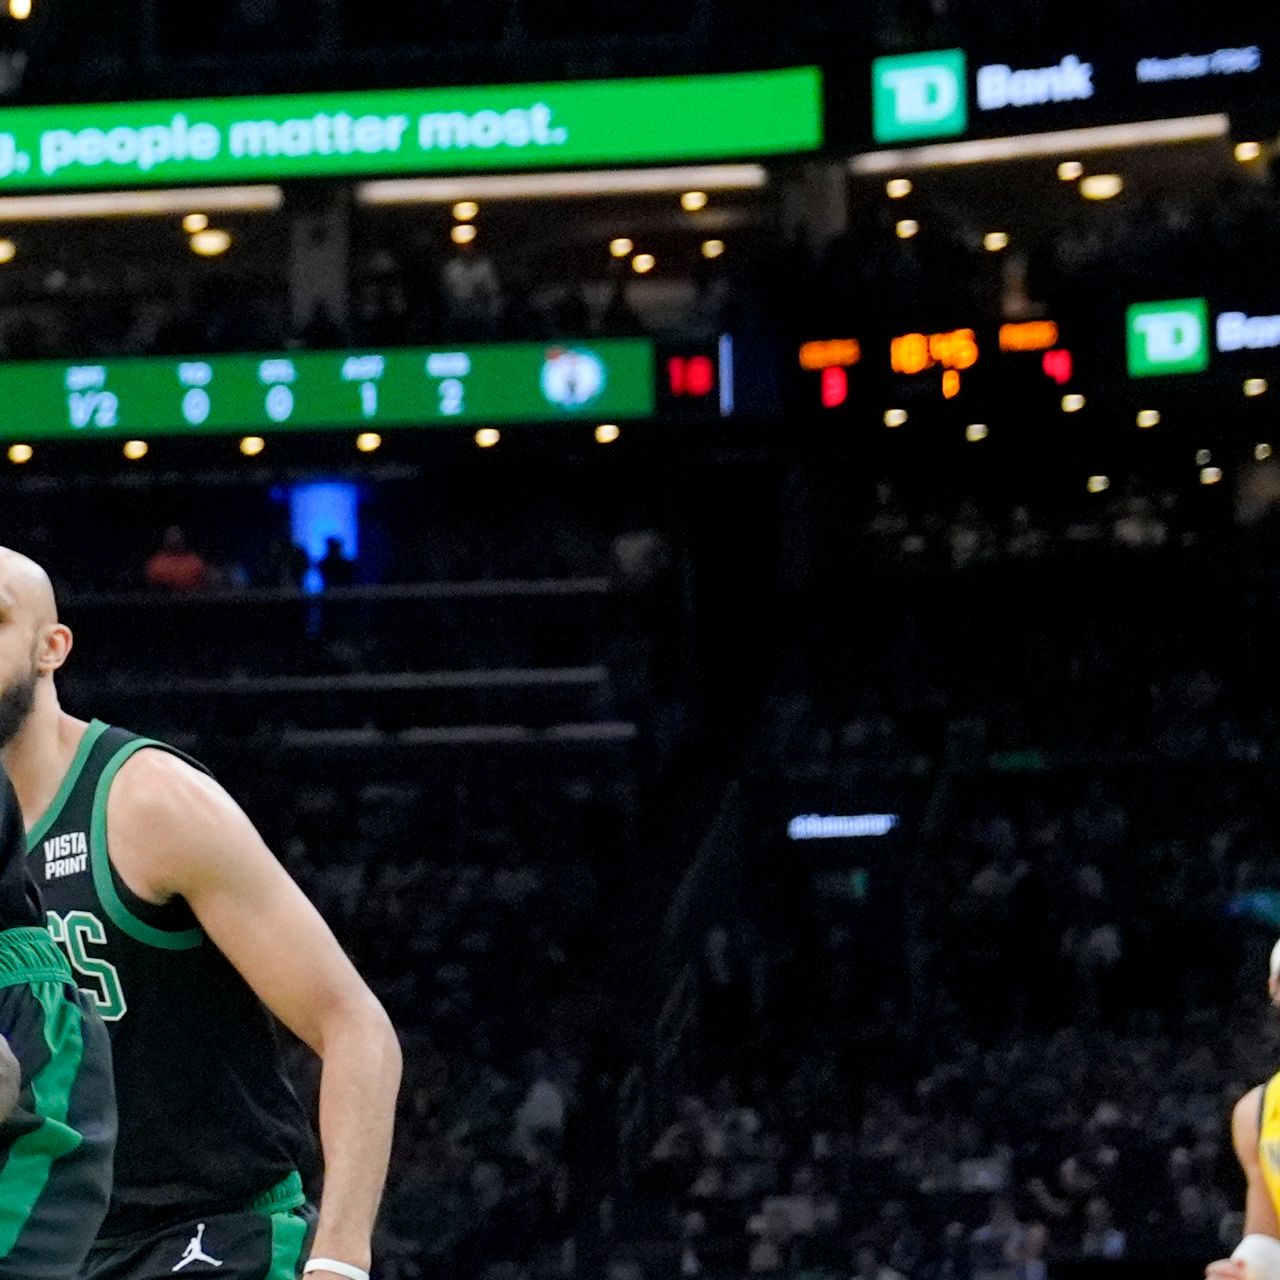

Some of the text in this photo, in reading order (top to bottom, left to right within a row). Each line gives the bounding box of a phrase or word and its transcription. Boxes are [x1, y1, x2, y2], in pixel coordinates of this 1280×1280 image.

[882, 66, 958, 123] TD
[977, 55, 1092, 110] Bank
[40, 115, 220, 174] people
[229, 113, 407, 156] matter
[418, 104, 566, 148] most.
[1134, 311, 1200, 362] TD
[44, 832, 88, 861] VISTA
[45, 854, 88, 880] PRINT
